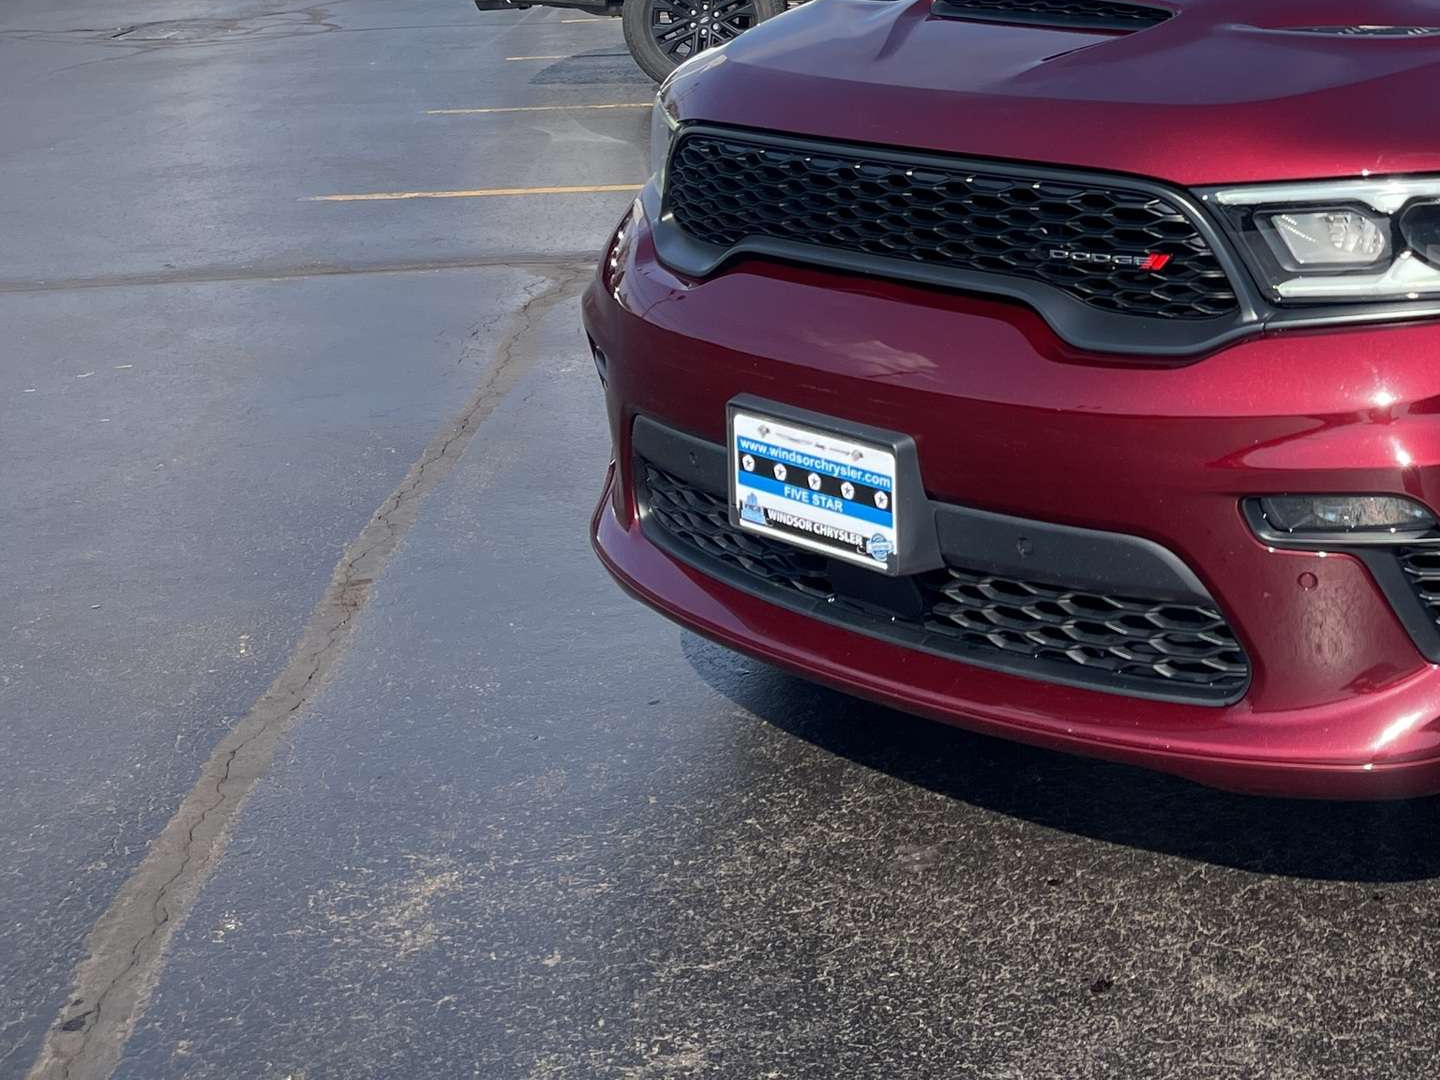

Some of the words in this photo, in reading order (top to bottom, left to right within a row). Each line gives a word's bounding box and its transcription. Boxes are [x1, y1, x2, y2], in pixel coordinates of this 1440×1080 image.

[1050, 249, 1151, 267] DODGE
[739, 437, 892, 488] www.windsorchrysler.com
[783, 485, 810, 504] FIVE
[813, 493, 844, 513] STAR
[768, 509, 814, 533] WINDSOR
[813, 522, 865, 546] CHRYSLER
